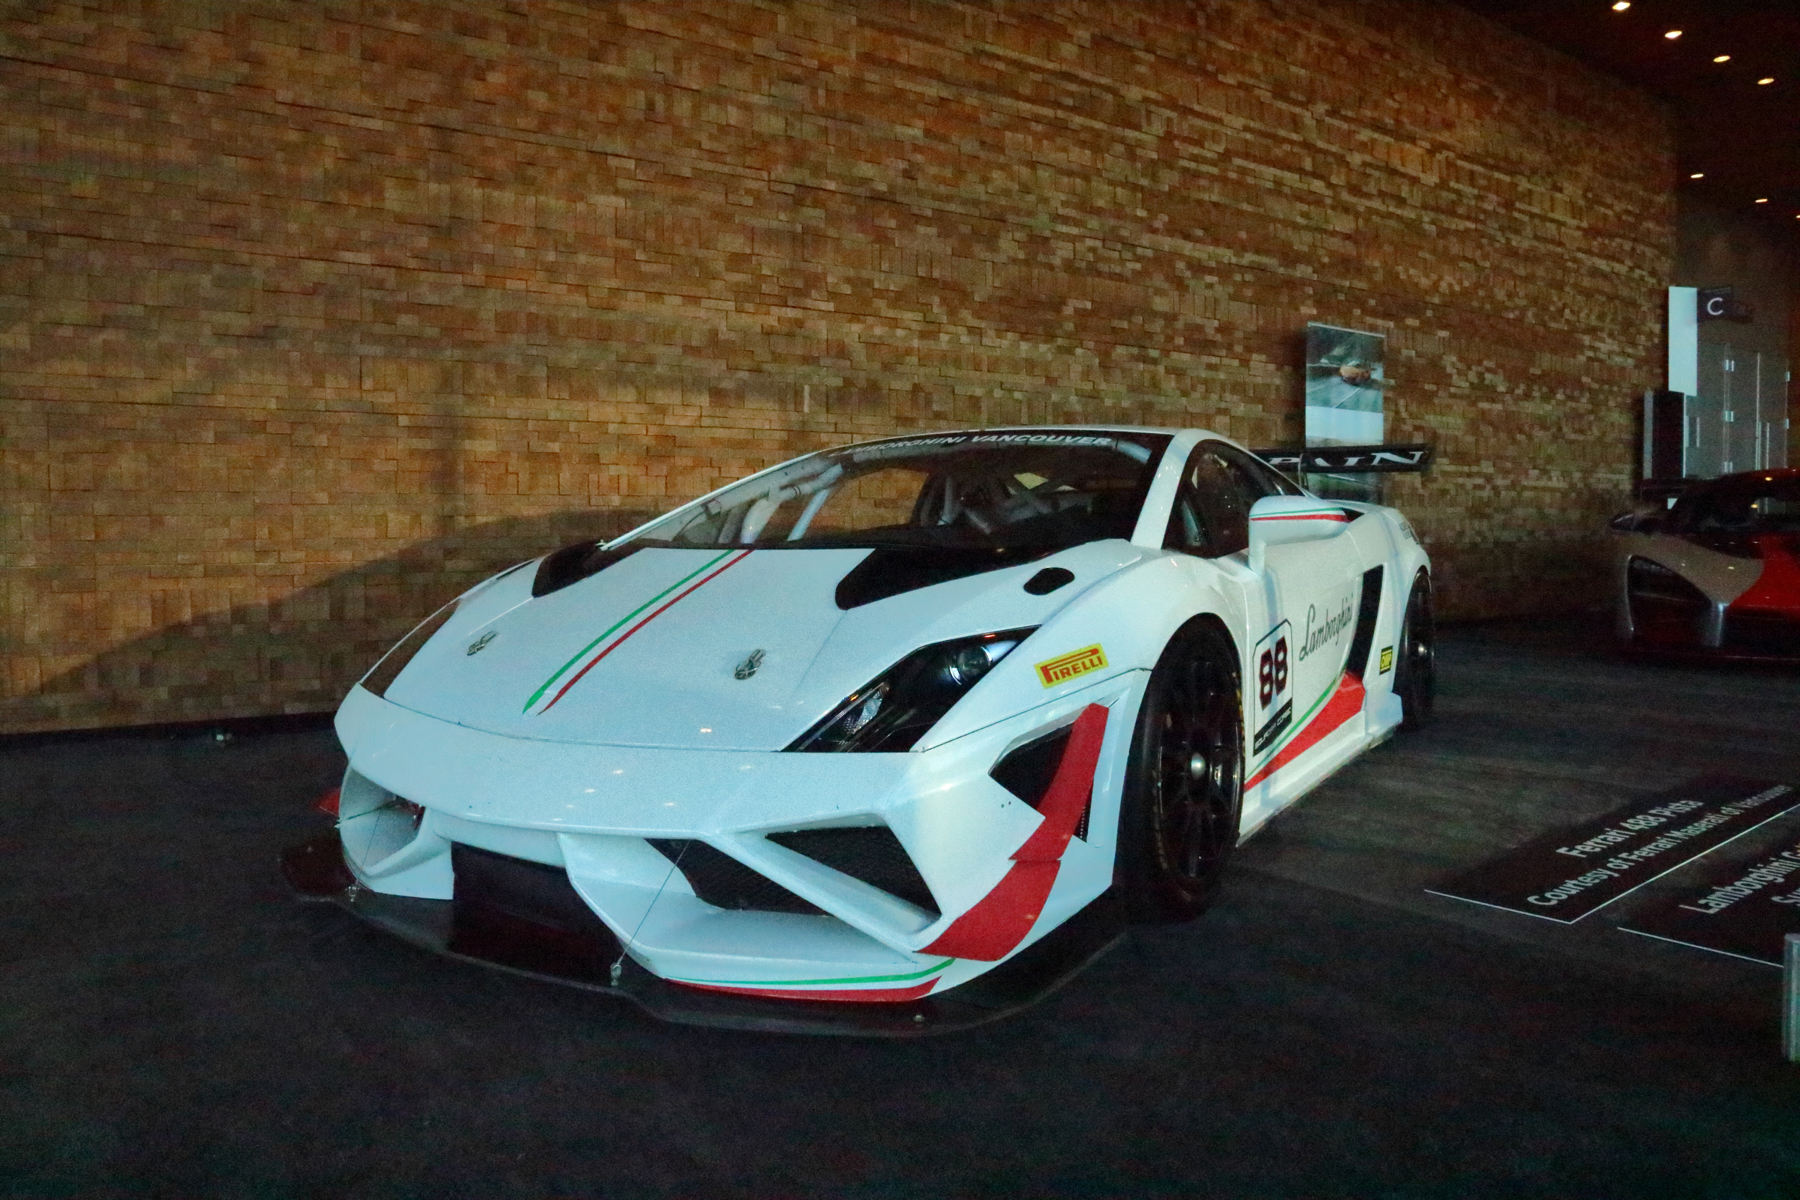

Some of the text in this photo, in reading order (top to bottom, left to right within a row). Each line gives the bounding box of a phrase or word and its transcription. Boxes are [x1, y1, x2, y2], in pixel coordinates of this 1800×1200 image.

[1707, 297, 1723, 316] C
[971, 434, 1112, 446] VANCOUVER
[1299, 592, 1354, 662] Lamborghini
[1041, 648, 1103, 684] PIRELLI
[1259, 635, 1288, 711] 88
[1556, 800, 1704, 858] Ferrari 488 Pista
[1664, 812, 1732, 839] Maserati
[1606, 858, 1636, 870] of
[1618, 836, 1682, 861] Ferrari
[1527, 868, 1620, 906] Courtesy
[1679, 857, 1800, 914] Lamborghini
